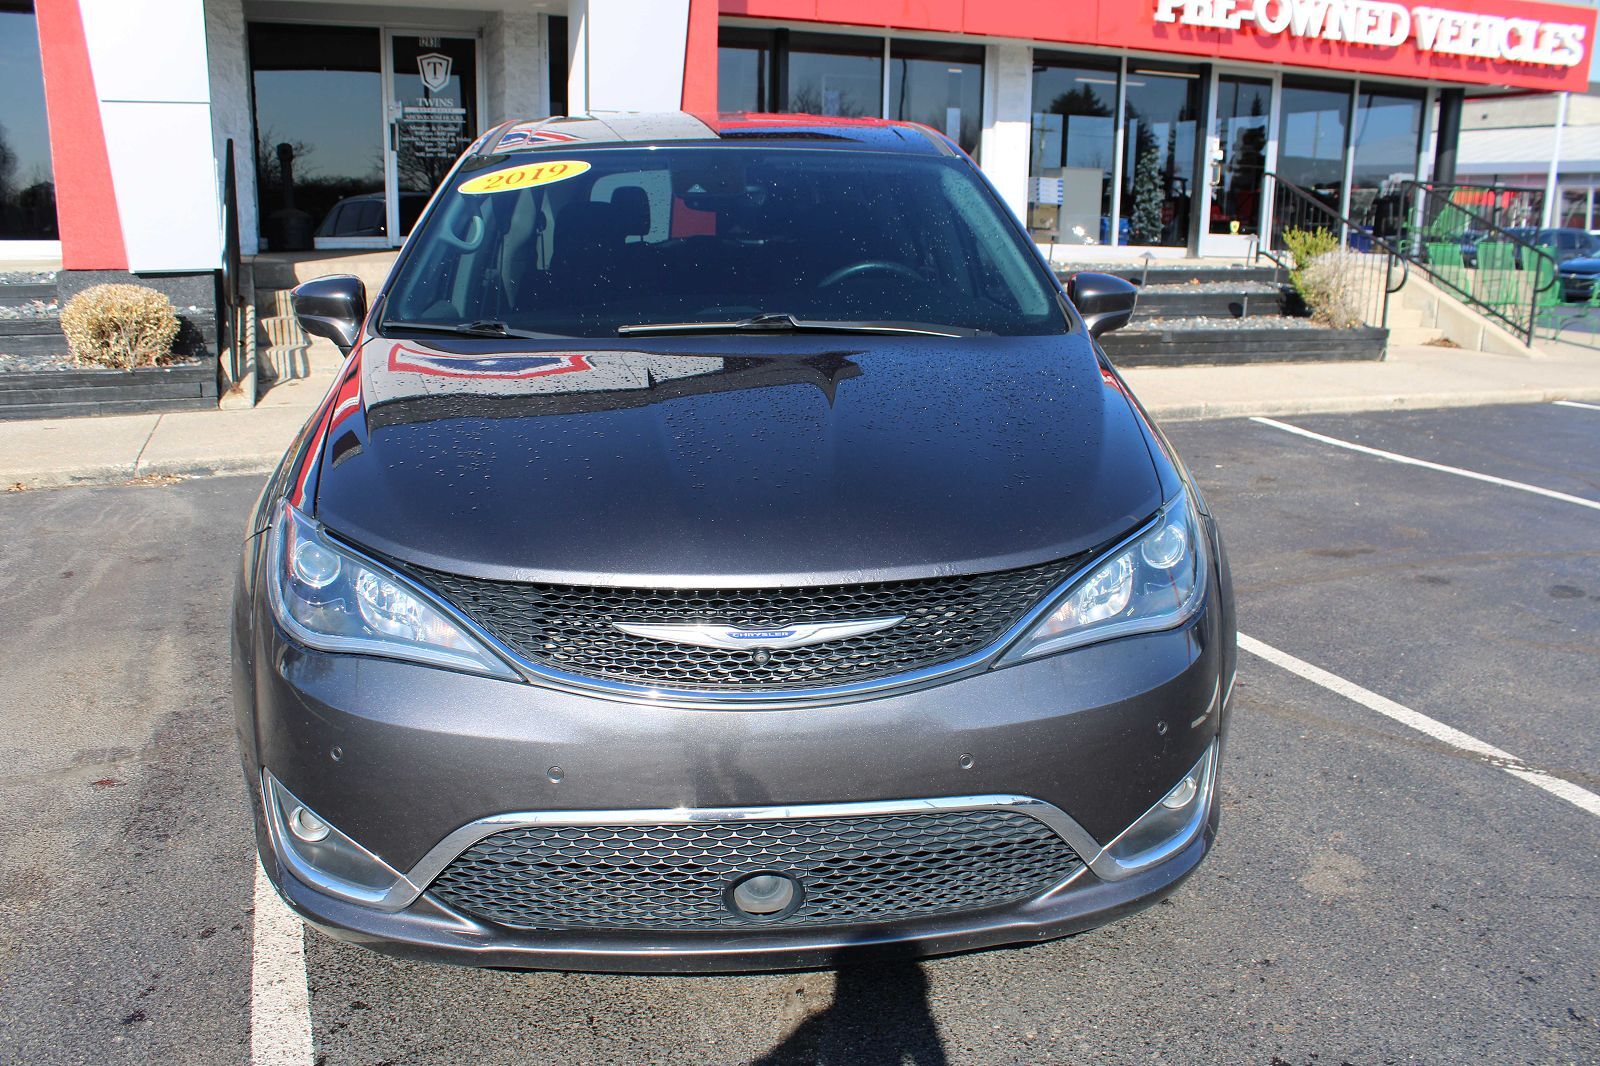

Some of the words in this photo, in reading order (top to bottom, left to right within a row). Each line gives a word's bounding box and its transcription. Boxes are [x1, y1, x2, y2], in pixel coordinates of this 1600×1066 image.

[1154, 0, 1410, 46] PRE-OWNED
[1411, 6, 1585, 67] VEHICLES
[416, 98, 454, 107] TWINS
[484, 163, 569, 190] 2019
